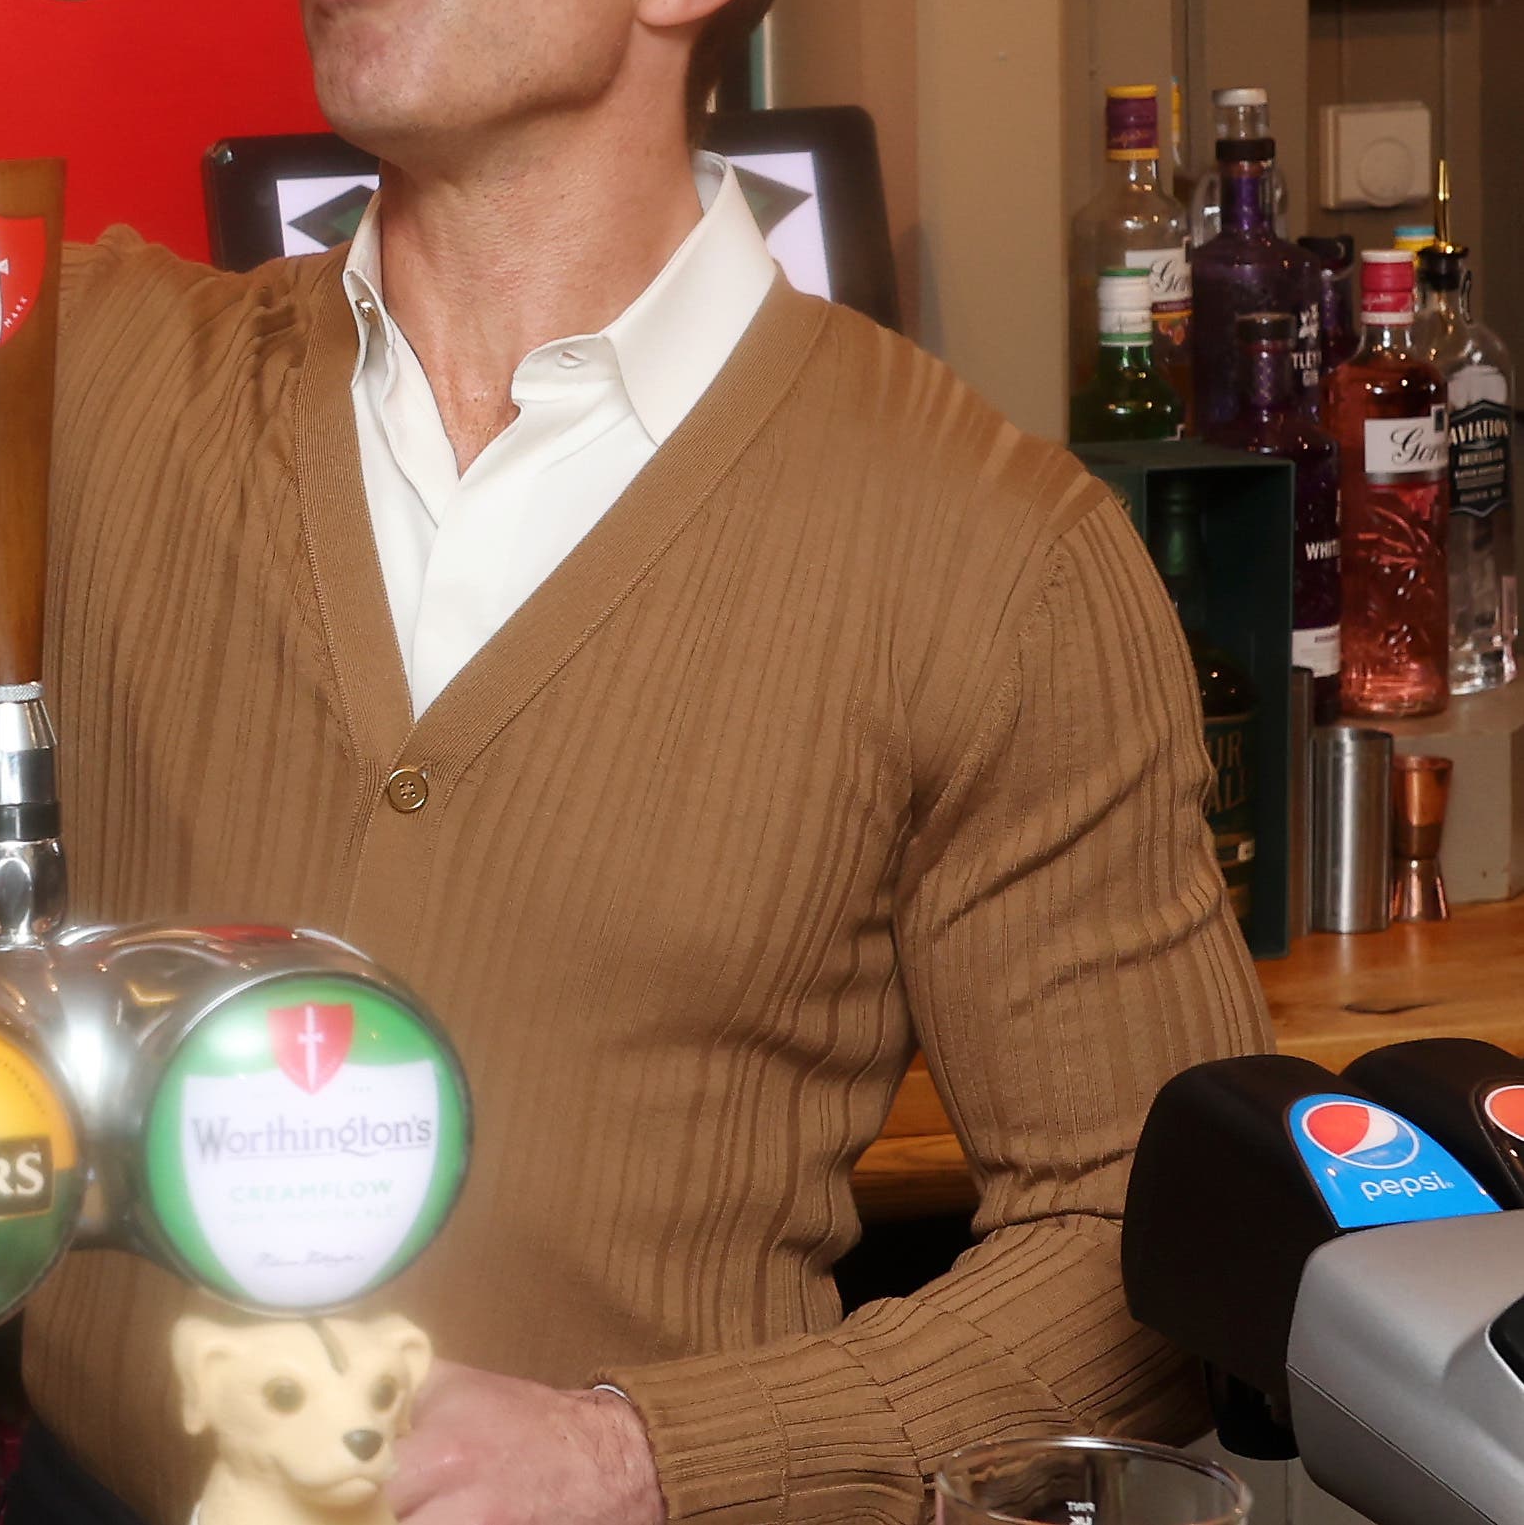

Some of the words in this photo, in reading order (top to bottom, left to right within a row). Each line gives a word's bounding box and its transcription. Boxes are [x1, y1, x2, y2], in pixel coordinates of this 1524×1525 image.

[3, 296, 29, 328] MARK
[1449, 419, 1509, 445] AVIATION
[190, 1114, 432, 1163] Worthington's
[230, 1179, 394, 1205] CREAMFLOW
[1360, 1171, 1448, 1202] pepsi
